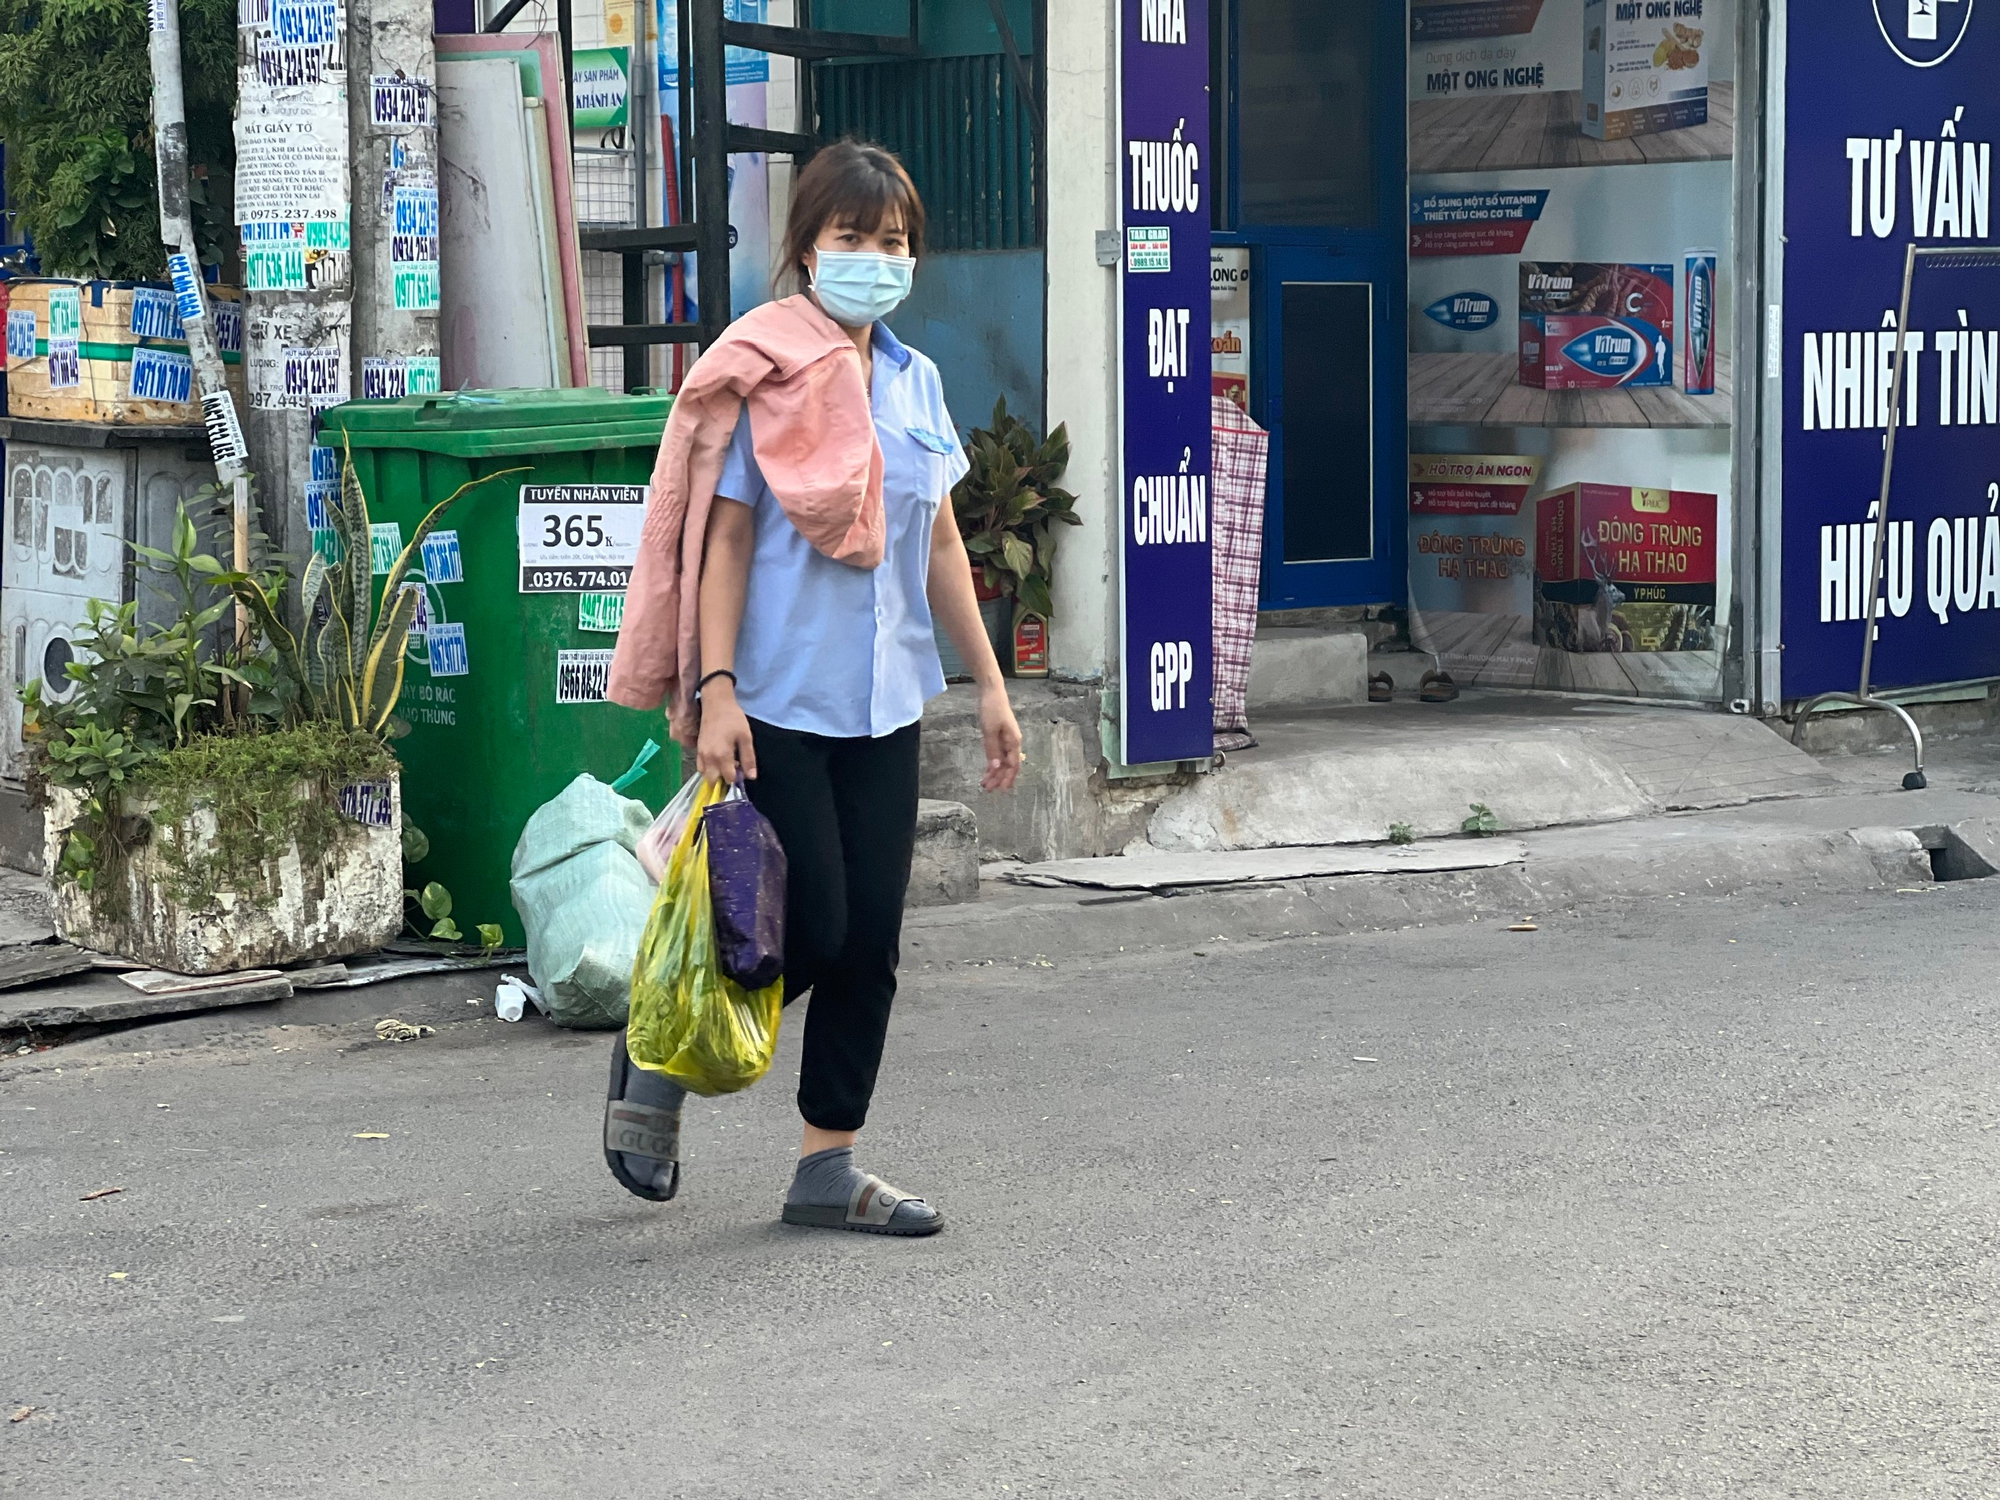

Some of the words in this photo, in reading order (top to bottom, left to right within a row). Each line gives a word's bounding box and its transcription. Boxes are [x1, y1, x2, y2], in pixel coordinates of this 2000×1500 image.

[1646, 2, 1670, 19] ONG
[1427, 69, 1460, 94] MẬT
[1465, 68, 1498, 88] ONG
[1504, 62, 1544, 88] NGHỆ
[1129, 117, 1199, 214] THUỐC
[1846, 128, 1902, 238] TƯ
[1909, 105, 1990, 238] VẤN
[251, 208, 338, 219] 0975.237.498
[1438, 198, 1462, 208] SUNG
[1464, 195, 1484, 210] MỘT
[1499, 195, 1537, 205] VITAMIN
[1470, 210, 1488, 218] CHO
[1211, 269, 1238, 281] ONG
[1148, 308, 1190, 394] ĐẠT
[1803, 309, 1924, 451] NHIỆT
[1935, 309, 2000, 426] TÌN
[1496, 465, 1532, 476] NGON
[574, 485, 609, 500] NHÂN
[611, 486, 639, 501] VIÊN
[1133, 445, 1206, 546] CHUẨN
[1418, 530, 1463, 555] ĐÔNG
[1470, 531, 1526, 556] TRÙNG
[1597, 516, 1644, 544] ĐÔNG
[1649, 520, 1702, 546] TRÙNG
[1439, 559, 1460, 580] HẠ
[1467, 557, 1509, 578] THẢO
[1618, 550, 1640, 577] HẠ
[1644, 546, 1687, 574] THẢO
[1820, 500, 1914, 641] HIỆU
[1927, 482, 2000, 625] QUẢ
[1634, 586, 1666, 600] YPHÚC
[1150, 641, 1193, 712] GPP
[436, 682, 456, 703] RÁC
[421, 705, 456, 725] THÙNG
